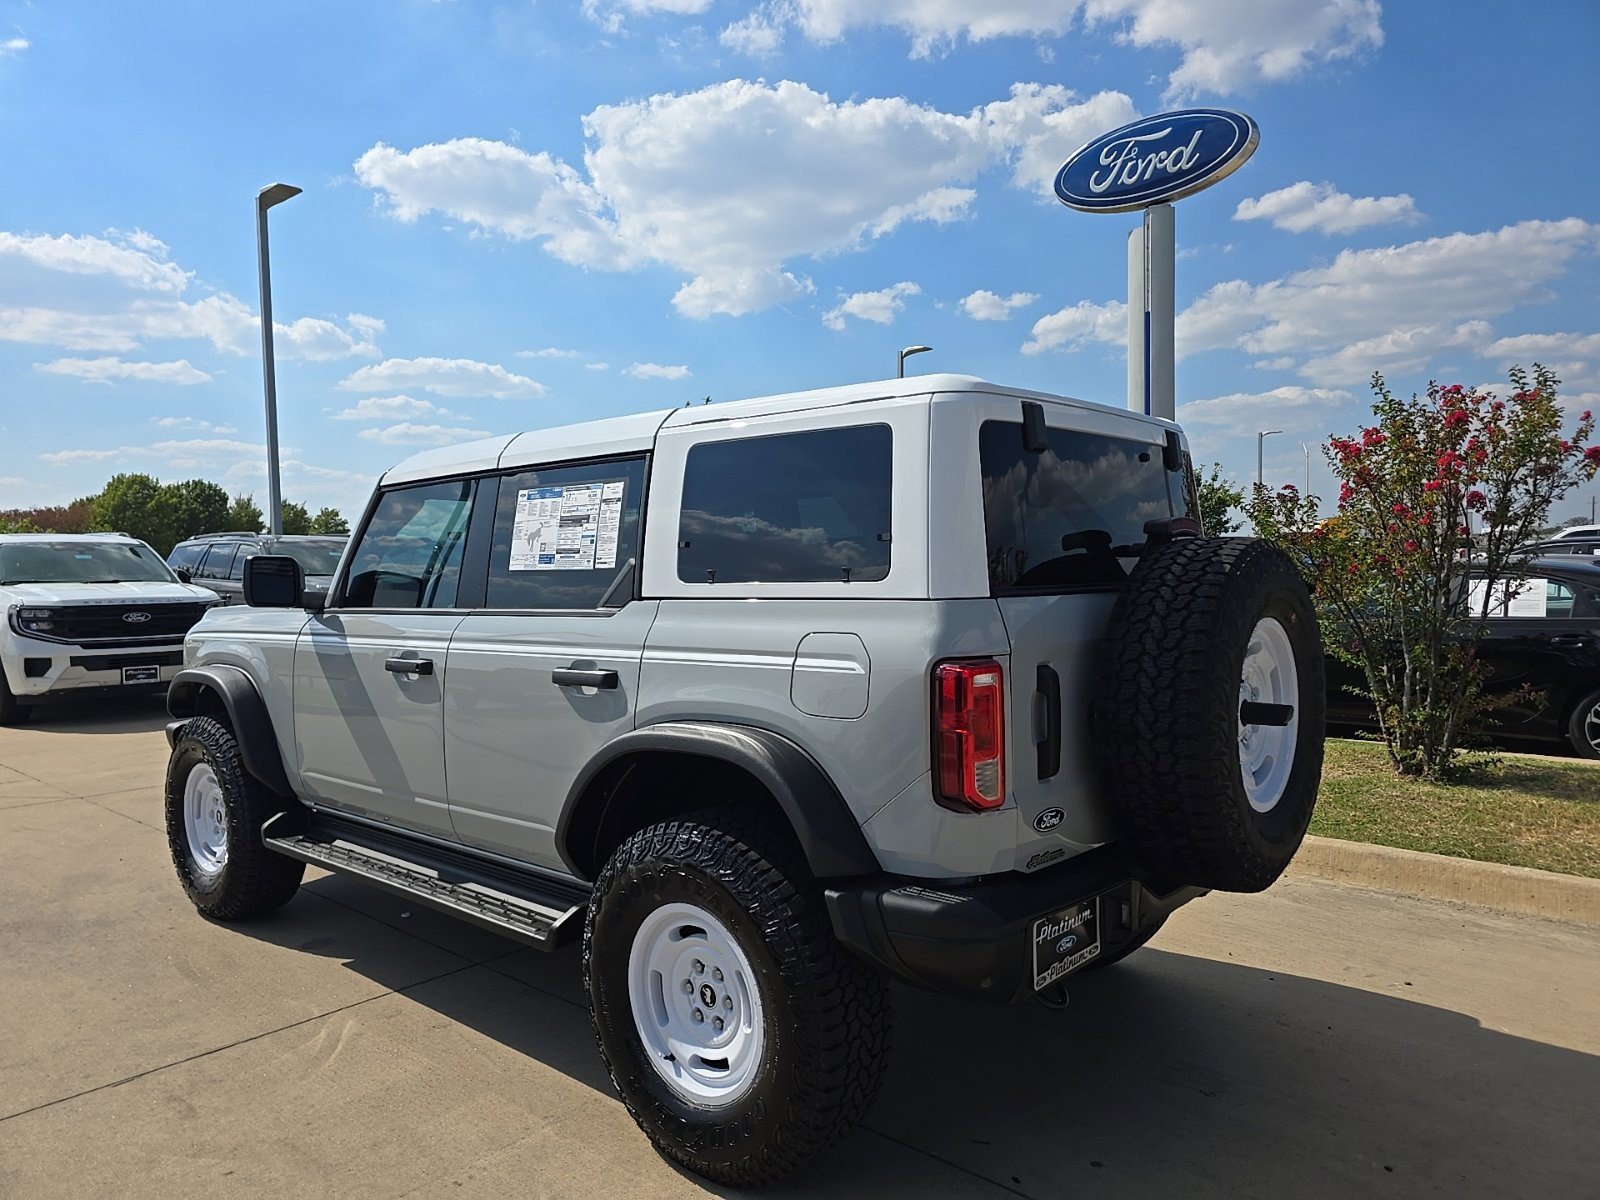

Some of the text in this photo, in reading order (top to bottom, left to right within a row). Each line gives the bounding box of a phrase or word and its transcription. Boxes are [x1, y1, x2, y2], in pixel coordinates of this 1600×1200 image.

[1089, 127, 1204, 193] Ford
[128, 612, 146, 622] Ford
[1040, 811, 1061, 828] Ford
[1036, 909, 1094, 945] Platinum
[1059, 937, 1074, 952] Ford
[1048, 948, 1088, 981] Platinum
